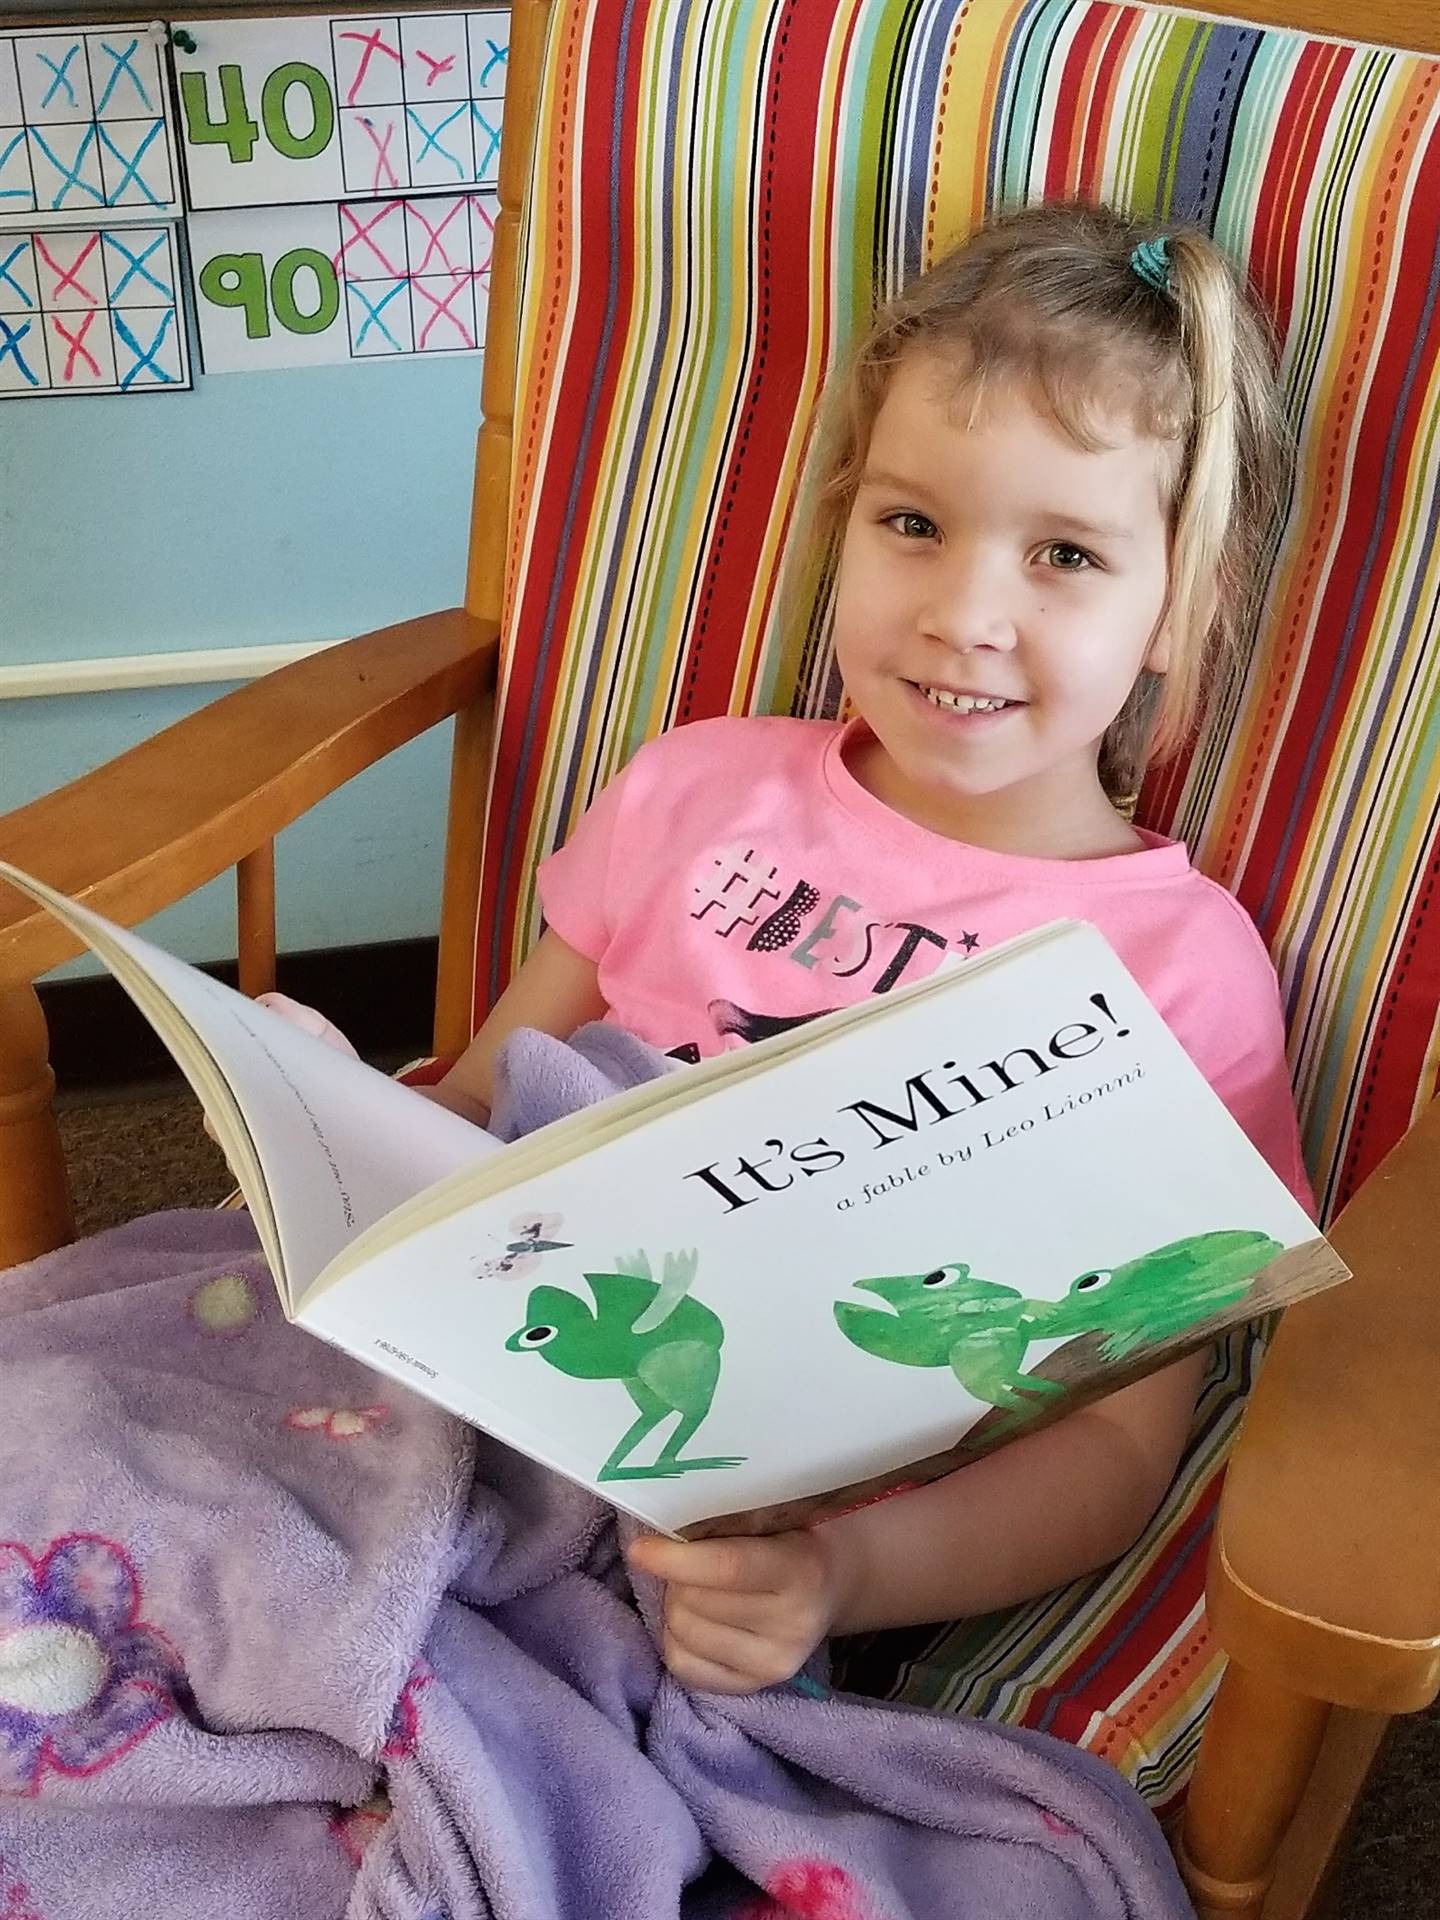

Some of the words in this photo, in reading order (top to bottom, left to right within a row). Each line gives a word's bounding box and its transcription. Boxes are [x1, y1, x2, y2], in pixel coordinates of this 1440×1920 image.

[180, 61, 334, 163] 40
[199, 247, 340, 340] 90
[682, 1136, 846, 1215] It's
[836, 992, 1131, 1150] Mine!
[836, 1196, 855, 1212] a
[861, 1161, 931, 1205] fable
[938, 1144, 974, 1168] by
[981, 1119, 1035, 1150] Leo
[1043, 1061, 1147, 1123] Lionni
